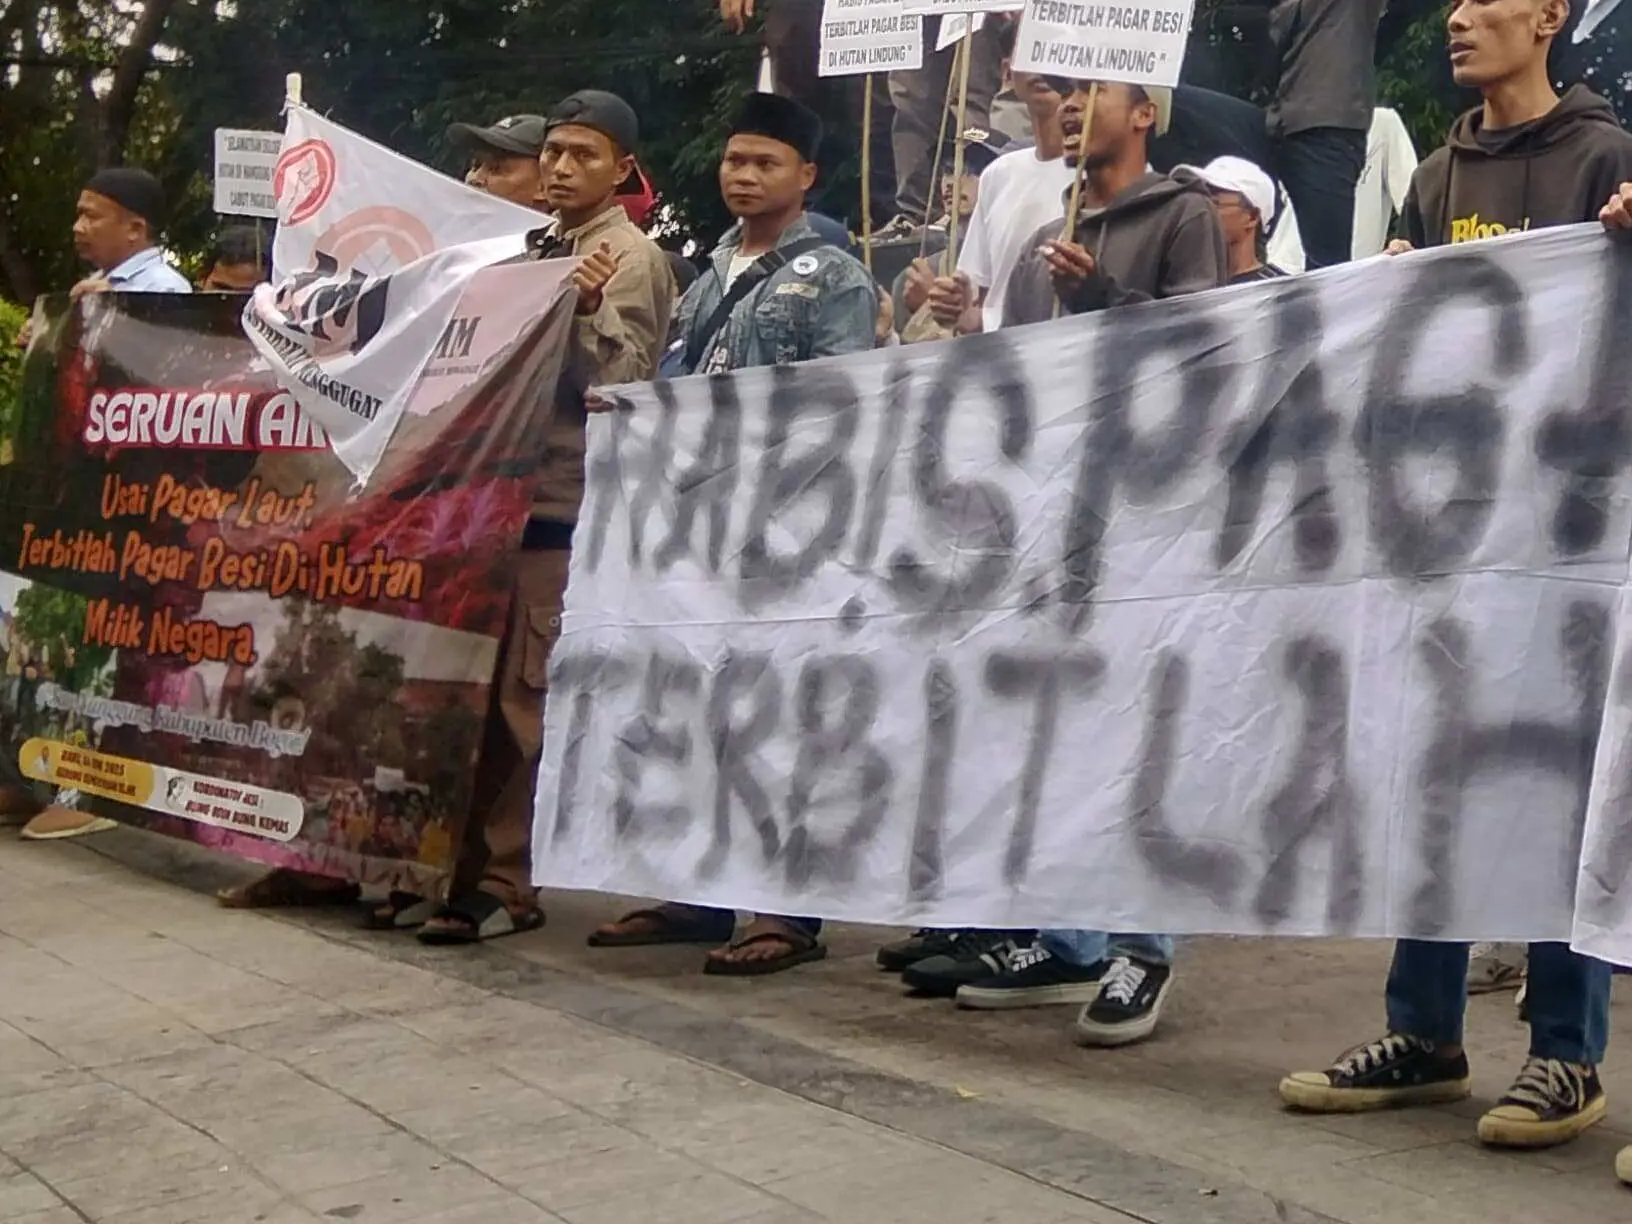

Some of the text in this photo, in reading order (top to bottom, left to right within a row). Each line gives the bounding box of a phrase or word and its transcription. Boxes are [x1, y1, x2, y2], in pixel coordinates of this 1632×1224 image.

[825, 14, 919, 39] TERBITLAH PAGAR BESI
[1106, 6, 1150, 33] PAGAR
[1151, 11, 1185, 34] BESI
[828, 51, 837, 67] DI
[839, 48, 867, 66] HUTAN
[868, 45, 906, 64] LINDUNG
[1031, 40, 1047, 63] DI
[1047, 43, 1096, 69] HUTAN
[1096, 48, 1157, 73] LINDUNG
[84, 391, 251, 445] SERUAN
[583, 334, 1036, 611] HABIS
[101, 473, 150, 520] Usai
[150, 473, 238, 525] Pagar
[18, 522, 424, 601] Terbitlah Pagar Besi Di Hutan
[83, 599, 145, 648] Milik
[550, 596, 1606, 944] TERBITLAH
